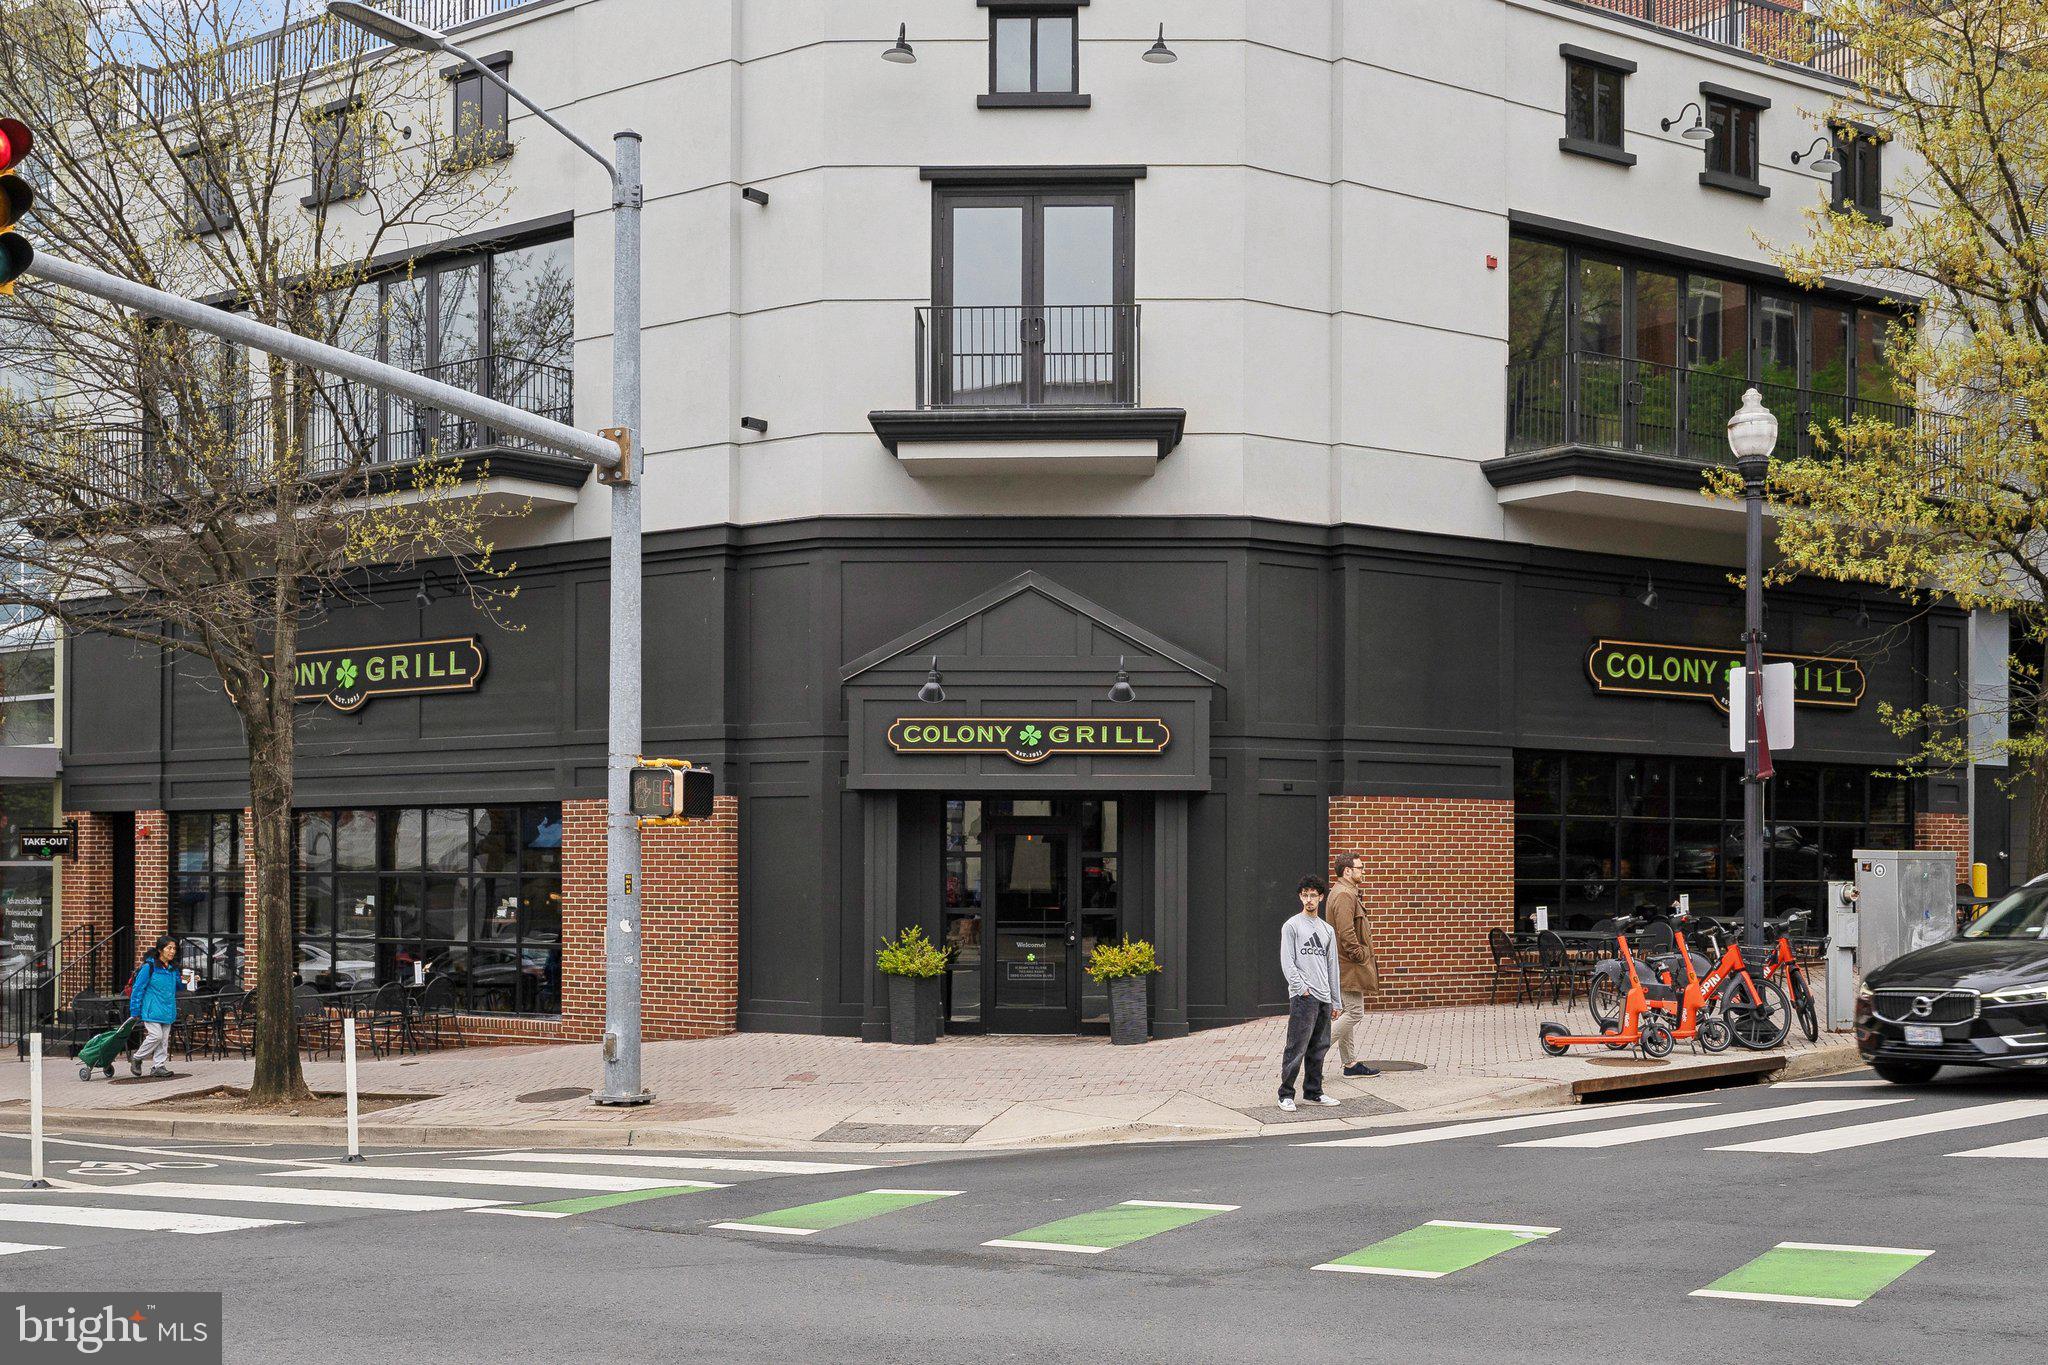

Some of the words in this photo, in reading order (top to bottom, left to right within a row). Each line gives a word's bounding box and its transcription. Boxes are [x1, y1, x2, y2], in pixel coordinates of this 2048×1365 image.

[365, 651, 467, 682] GRILL
[1606, 652, 1718, 685] COLONY
[1794, 666, 1852, 694] ILL
[903, 725, 1012, 743] COLONY
[1049, 725, 1154, 744] GRILL
[23, 837, 69, 846] TAKE-OUT
[1700, 973, 1722, 996] SPIN
